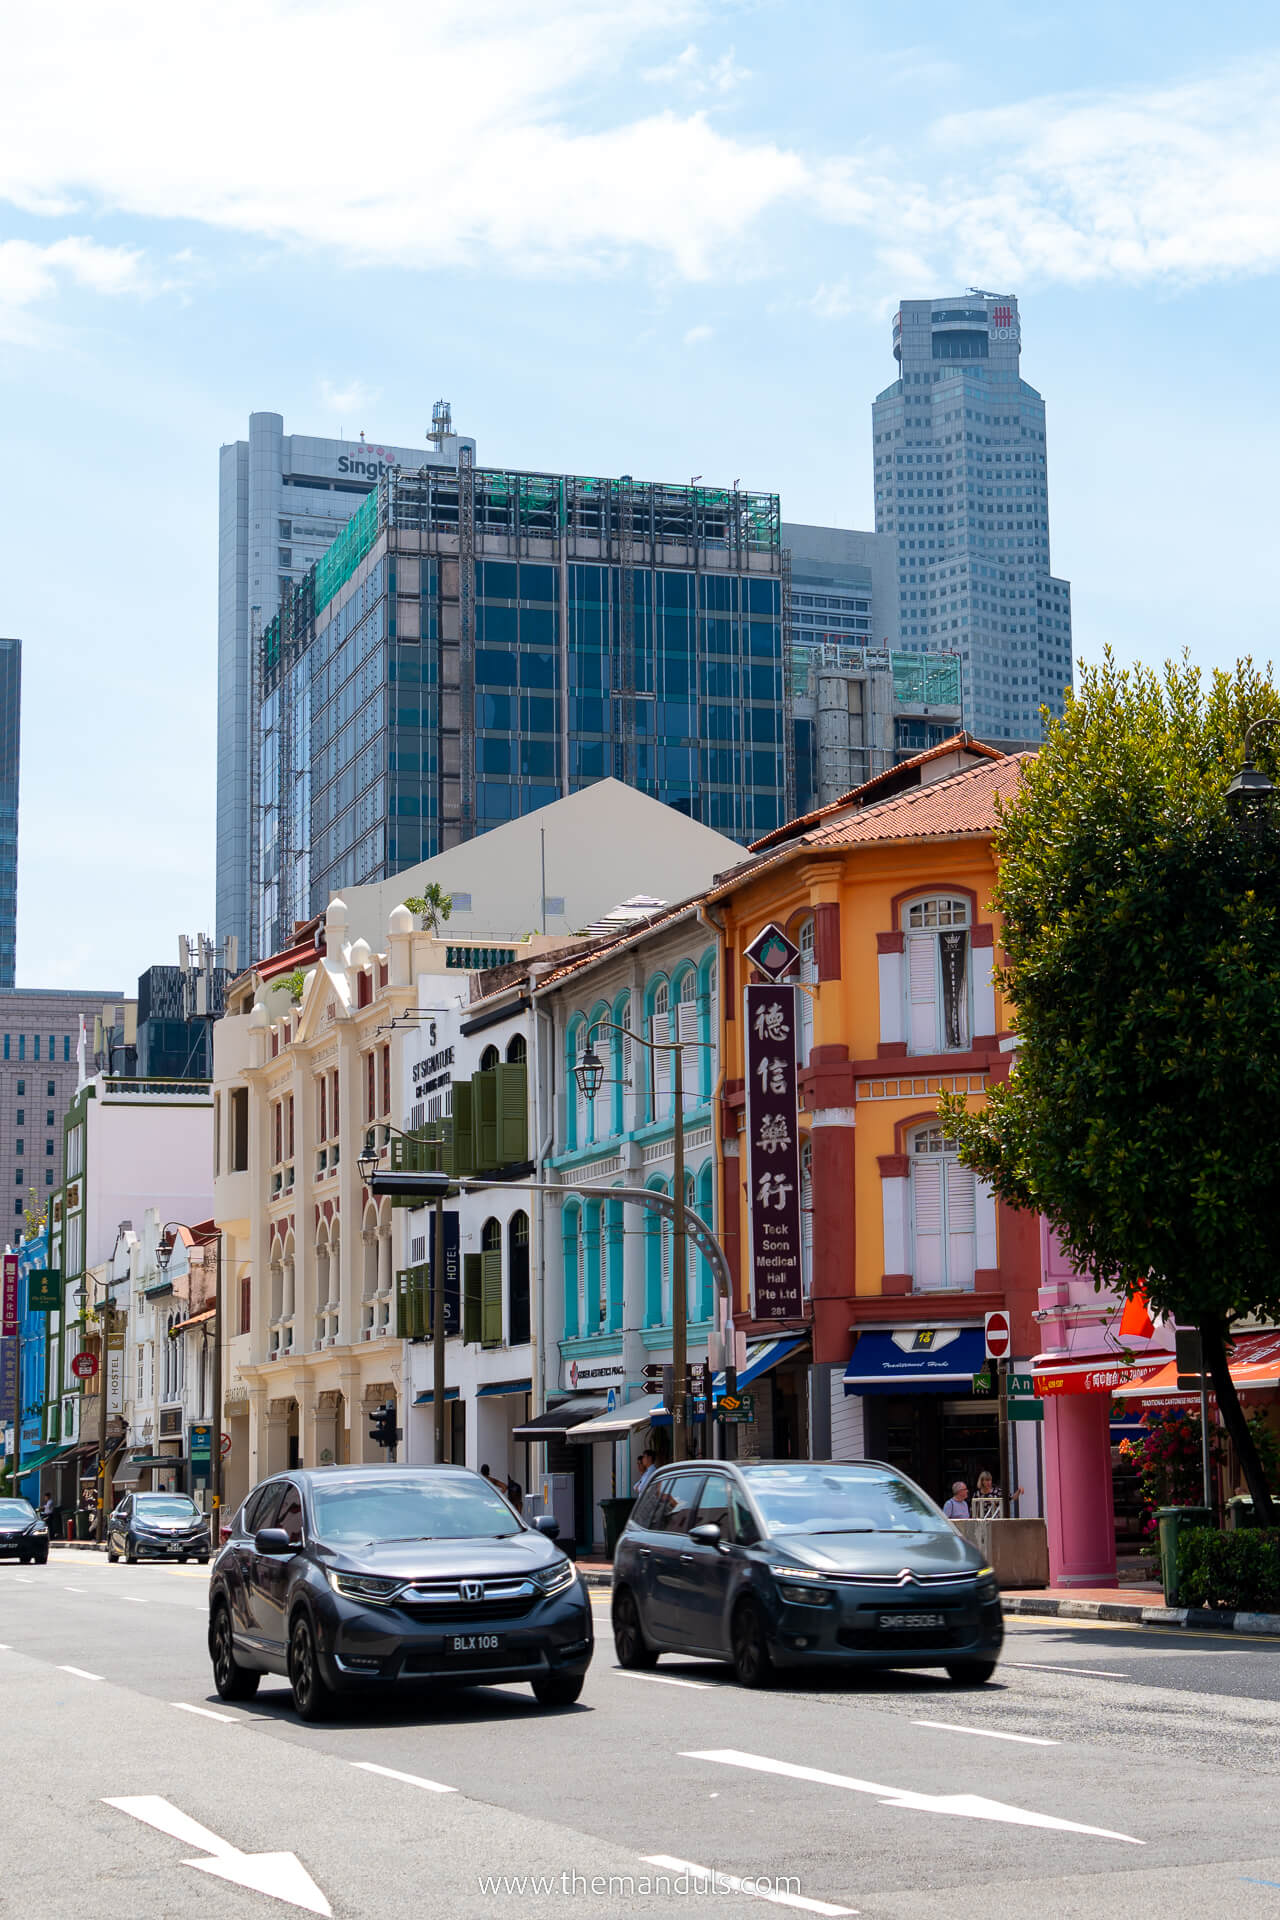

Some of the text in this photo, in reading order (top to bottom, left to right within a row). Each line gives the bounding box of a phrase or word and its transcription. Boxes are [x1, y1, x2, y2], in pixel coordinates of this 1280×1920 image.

[988, 328, 1019, 340] UOB
[420, 1045, 455, 1078] SIGNATURE
[762, 1223, 789, 1234] Teck
[762, 1239, 790, 1251] Soon
[446, 1244, 457, 1280] HOTEL
[756, 1255, 797, 1267] Medical
[767, 1272, 786, 1284] Hall
[758, 1288, 797, 1300] Pte Ltd
[111, 1355, 119, 1395] HOSTEL
[454, 1635, 498, 1650] BLX 108
